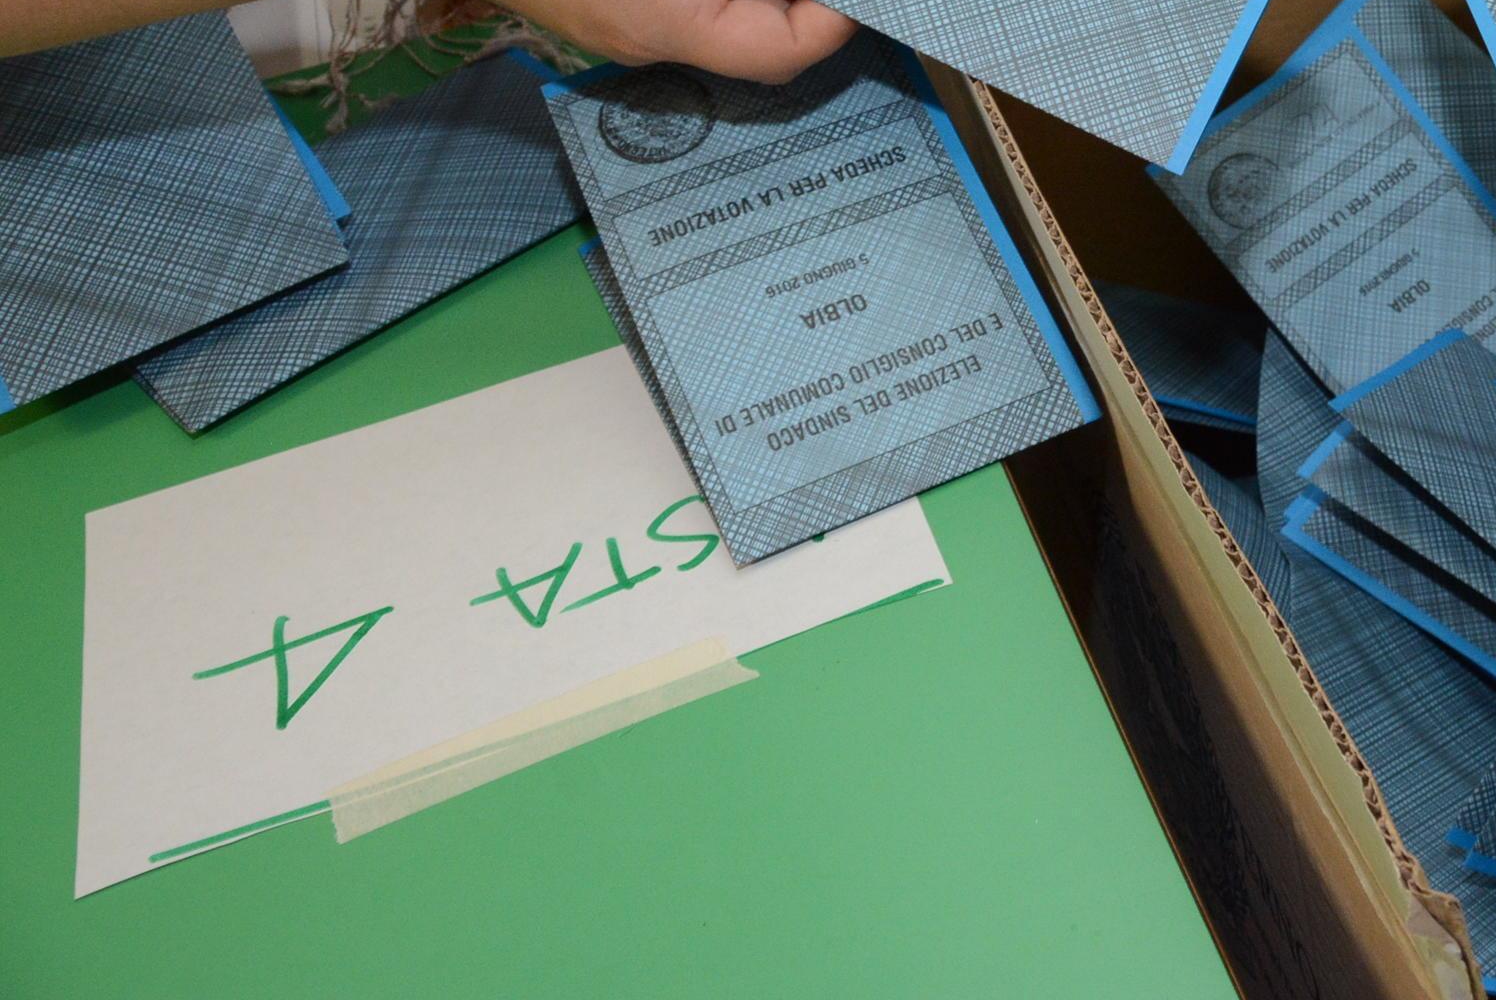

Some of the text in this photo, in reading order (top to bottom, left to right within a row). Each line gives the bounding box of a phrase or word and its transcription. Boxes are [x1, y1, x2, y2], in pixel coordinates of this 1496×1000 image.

[646, 144, 906, 247] SCHEDA PER LA VOTAZIONE
[1263, 156, 1418, 274] SCHEDA PER LA VOTAZIONE
[763, 252, 868, 298] 5 GIUGNO 2016
[799, 291, 867, 331] OLBIA
[1387, 277, 1431, 315] OLBIA
[714, 311, 1002, 436] E DEL CONSIGLIO COMUNALE DI
[765, 353, 980, 451] ELEZIONE DEL SINDACO
[192, 604, 395, 731] 4
